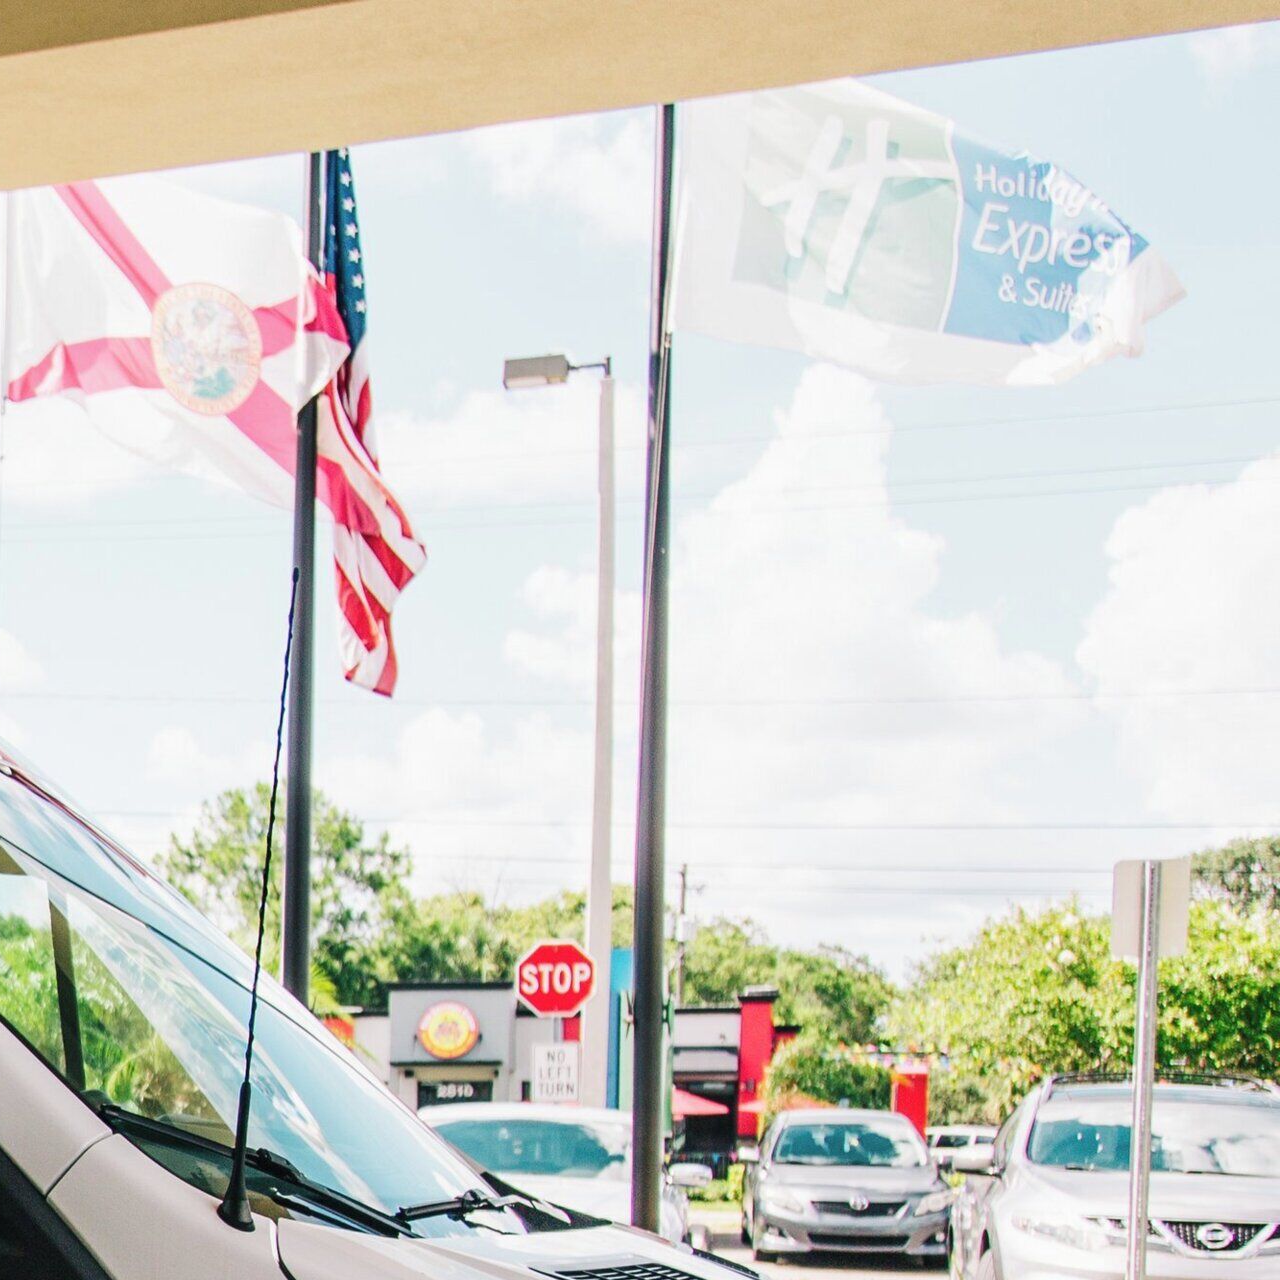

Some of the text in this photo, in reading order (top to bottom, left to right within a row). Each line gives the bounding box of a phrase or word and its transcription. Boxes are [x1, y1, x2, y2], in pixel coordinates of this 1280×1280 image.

[998, 274, 1017, 304] &
[521, 963, 592, 995] STOP
[546, 1050, 566, 1064] NO
[539, 1067, 572, 1080] LEFT
[539, 1083, 575, 1097] TURN
